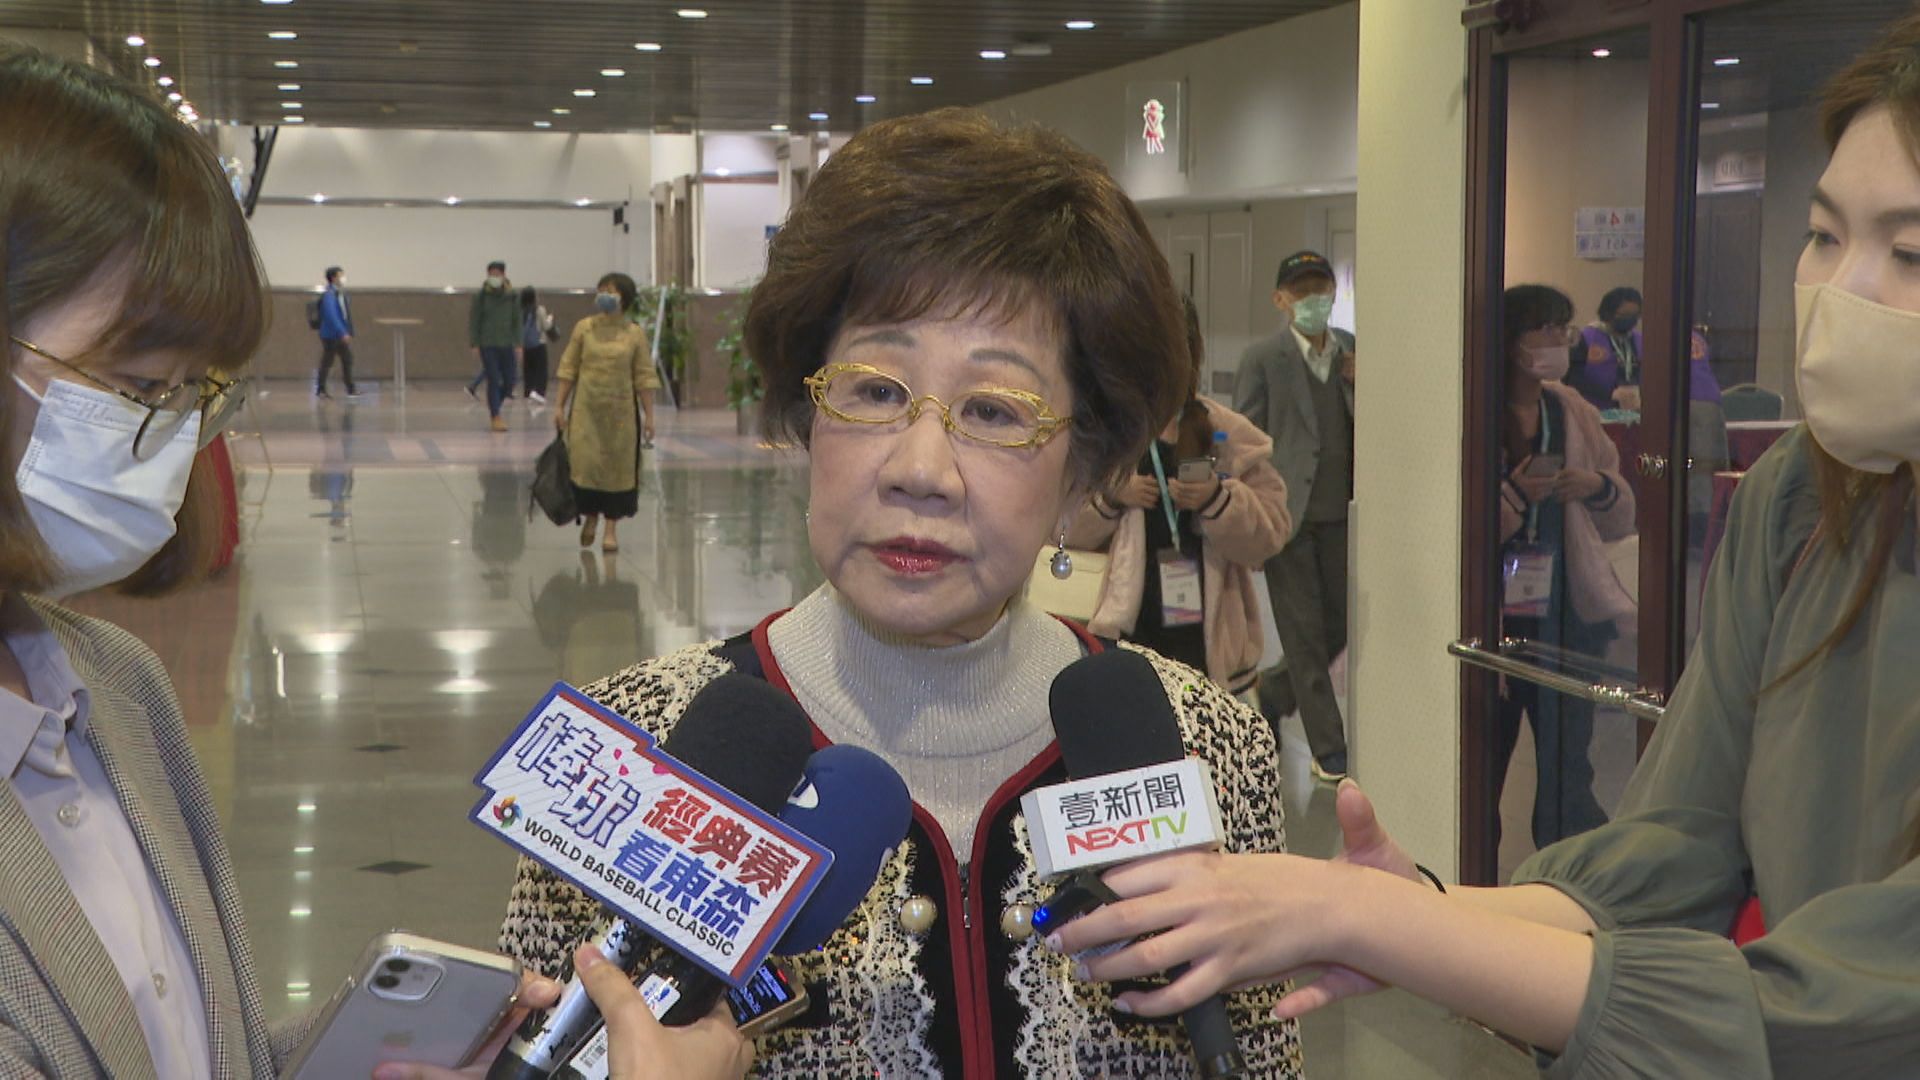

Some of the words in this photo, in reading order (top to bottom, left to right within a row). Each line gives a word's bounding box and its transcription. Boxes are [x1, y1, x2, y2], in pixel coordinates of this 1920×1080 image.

[516, 713, 641, 848] 棒球
[1059, 773, 1185, 830] 壹新聞
[524, 817, 581, 862] WORLD
[582, 855, 662, 914] BASEBALL
[666, 906, 735, 957] CLASSIC
[613, 829, 760, 940] 看東森
[642, 786, 799, 897] 經典賽
